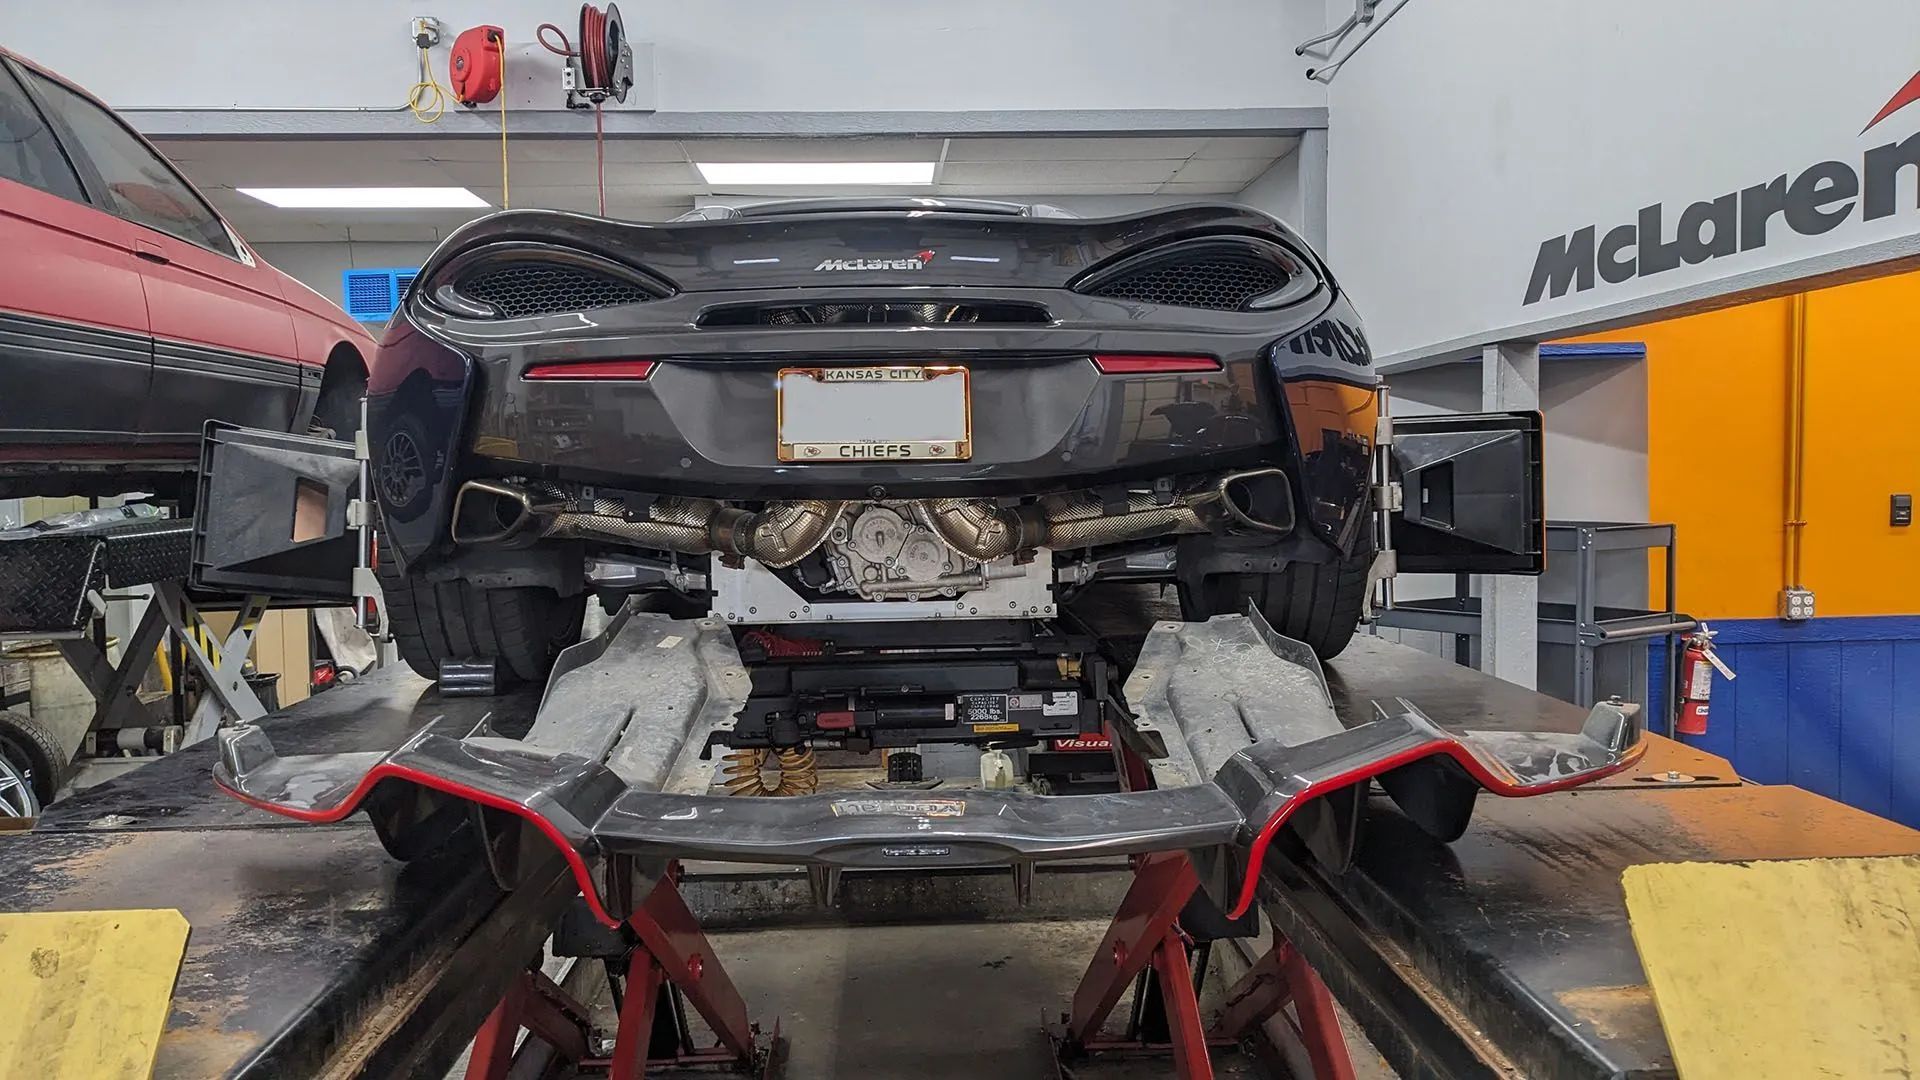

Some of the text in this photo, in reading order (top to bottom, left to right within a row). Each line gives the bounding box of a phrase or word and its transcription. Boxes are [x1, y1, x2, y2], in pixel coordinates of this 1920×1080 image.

[1522, 131, 1920, 306] McLaren
[814, 258, 923, 271] McLaren
[825, 369, 921, 380] KANSAS CITY
[839, 445, 912, 457] CHIEFS
[1056, 739, 1113, 748] Visua
